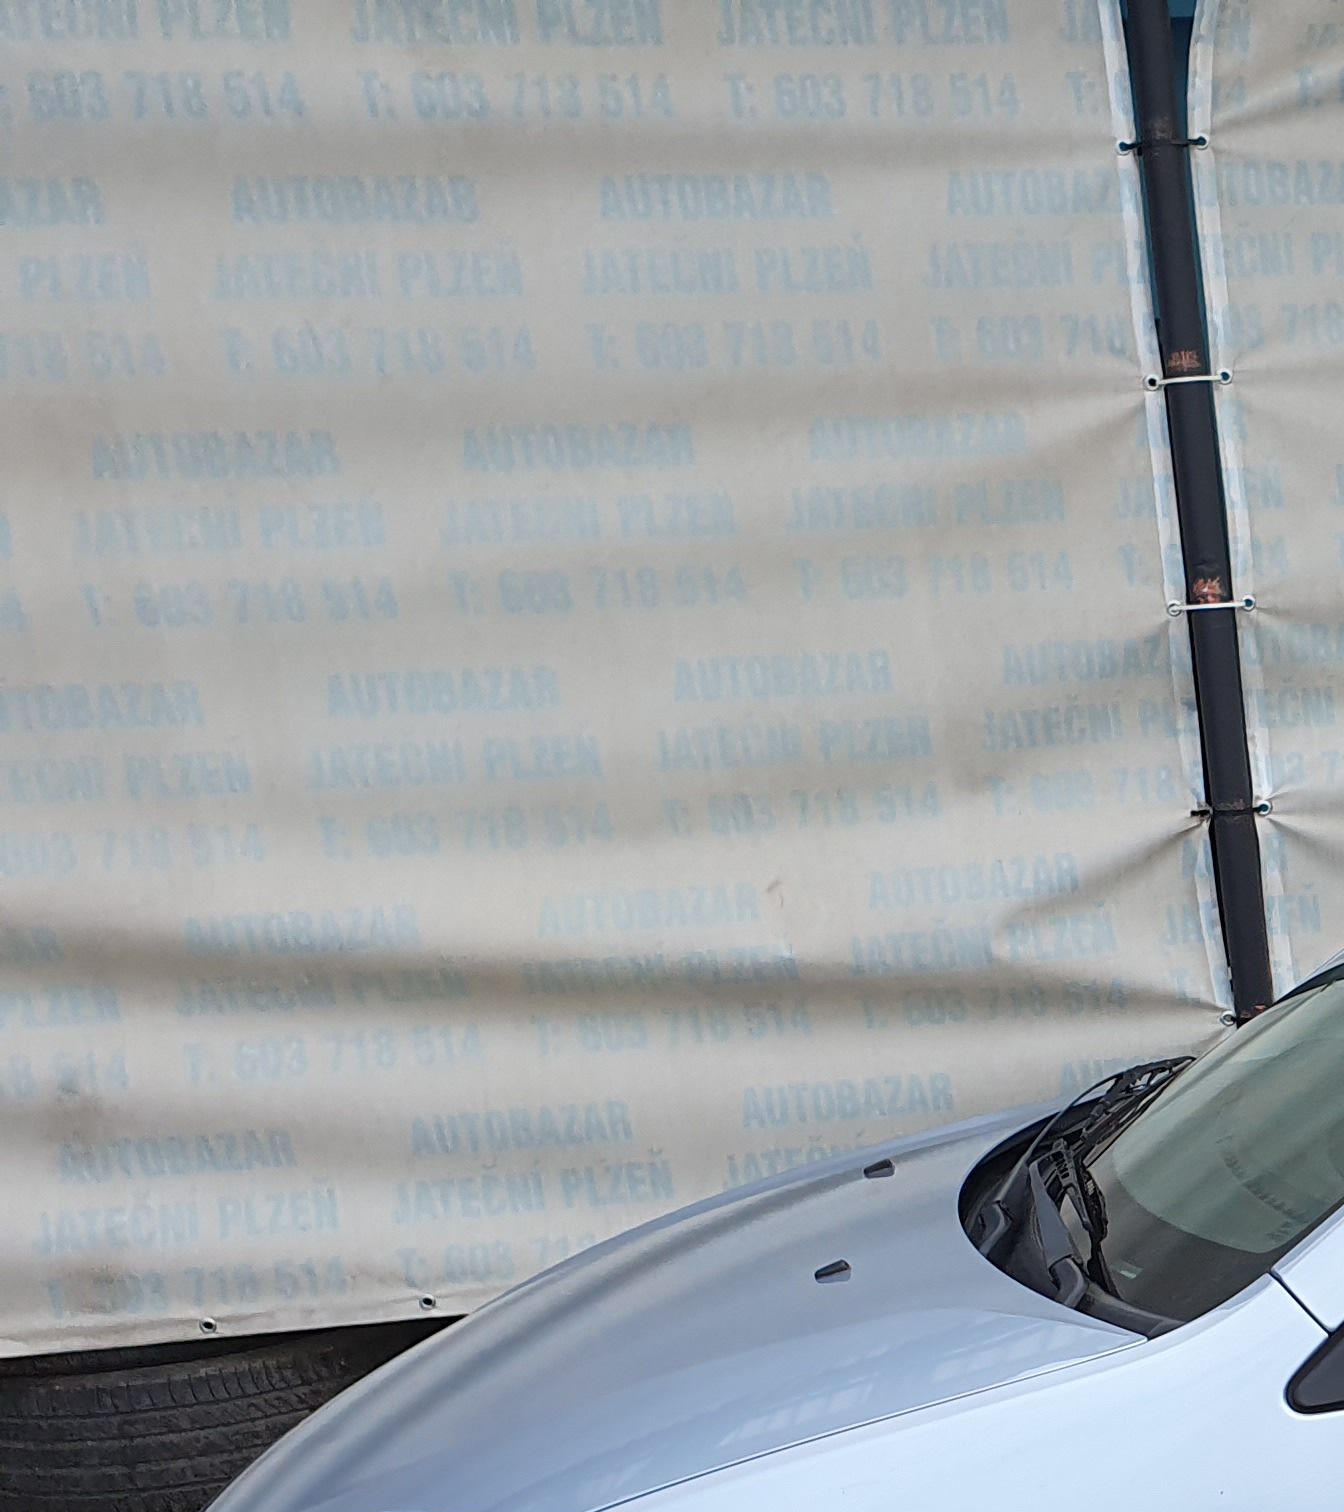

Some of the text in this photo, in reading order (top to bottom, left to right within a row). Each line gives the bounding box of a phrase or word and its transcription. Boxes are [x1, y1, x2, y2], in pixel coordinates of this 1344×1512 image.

[231, 174, 481, 224] AUTOBAZAR
[598, 172, 834, 220] AUTOBAZAR
[91, 430, 343, 481] AUTOBAZAR
[461, 421, 695, 474] AUTOBAZAR
[327, 668, 557, 720] AUTOBAZAR
[674, 650, 893, 704] AUTOBAZAR
[869, 852, 1079, 910] AUTOBAZAR
[184, 903, 421, 956] AUTOBAZAR
[538, 881, 760, 937] AUTOBAZAR
[742, 1072, 951, 1129] AUTOBAZAR
[410, 1099, 632, 1158] AUTOBAZAR
[58, 1128, 297, 1183] AUTOBAZAR
